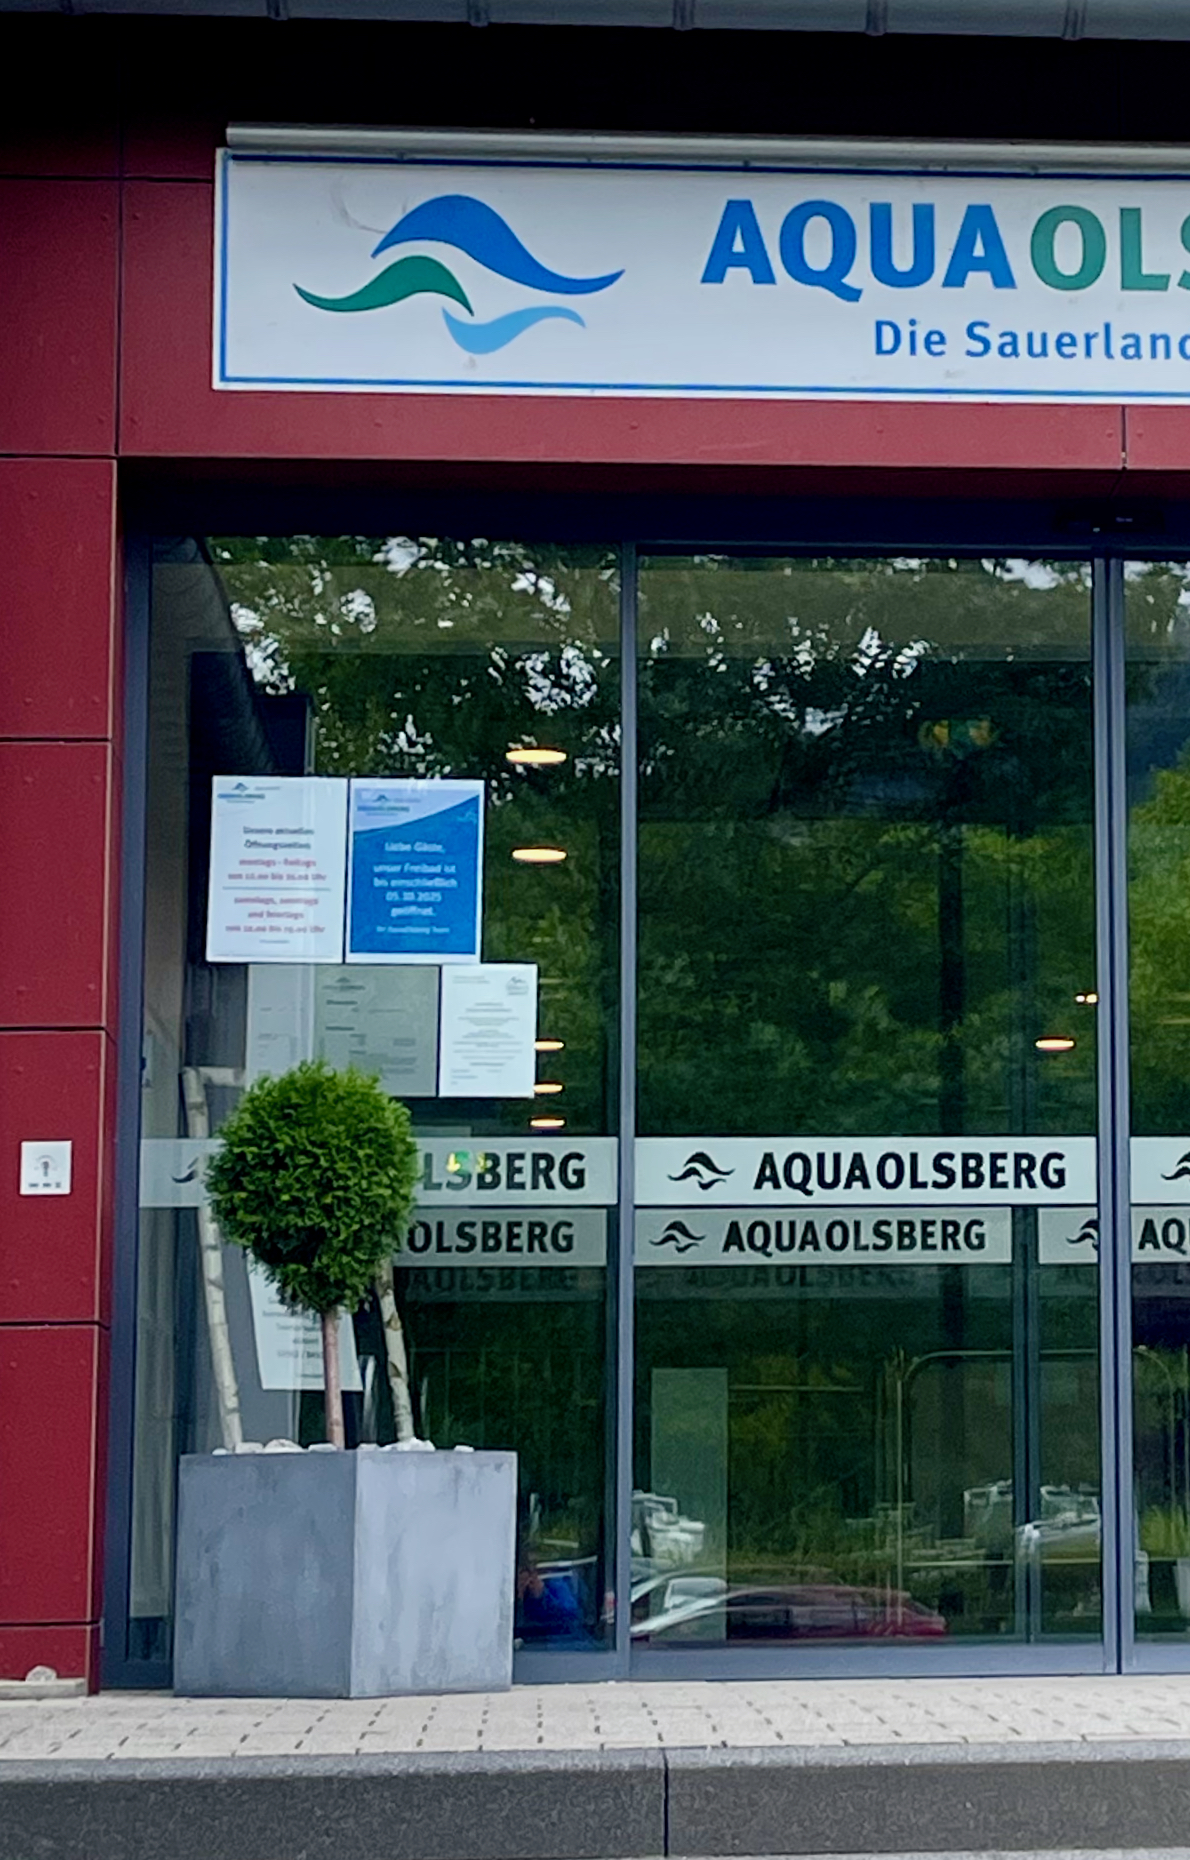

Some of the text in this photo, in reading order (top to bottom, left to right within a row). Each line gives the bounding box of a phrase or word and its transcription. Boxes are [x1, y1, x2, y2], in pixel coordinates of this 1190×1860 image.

[875, 318, 947, 357] Die
[420, 1151, 586, 1191] LSBERG
[753, 1151, 1066, 1196] AQUAOLSBERG
[406, 1219, 574, 1254] OLSBERG
[721, 1219, 986, 1258] AQUAOLSBERG
